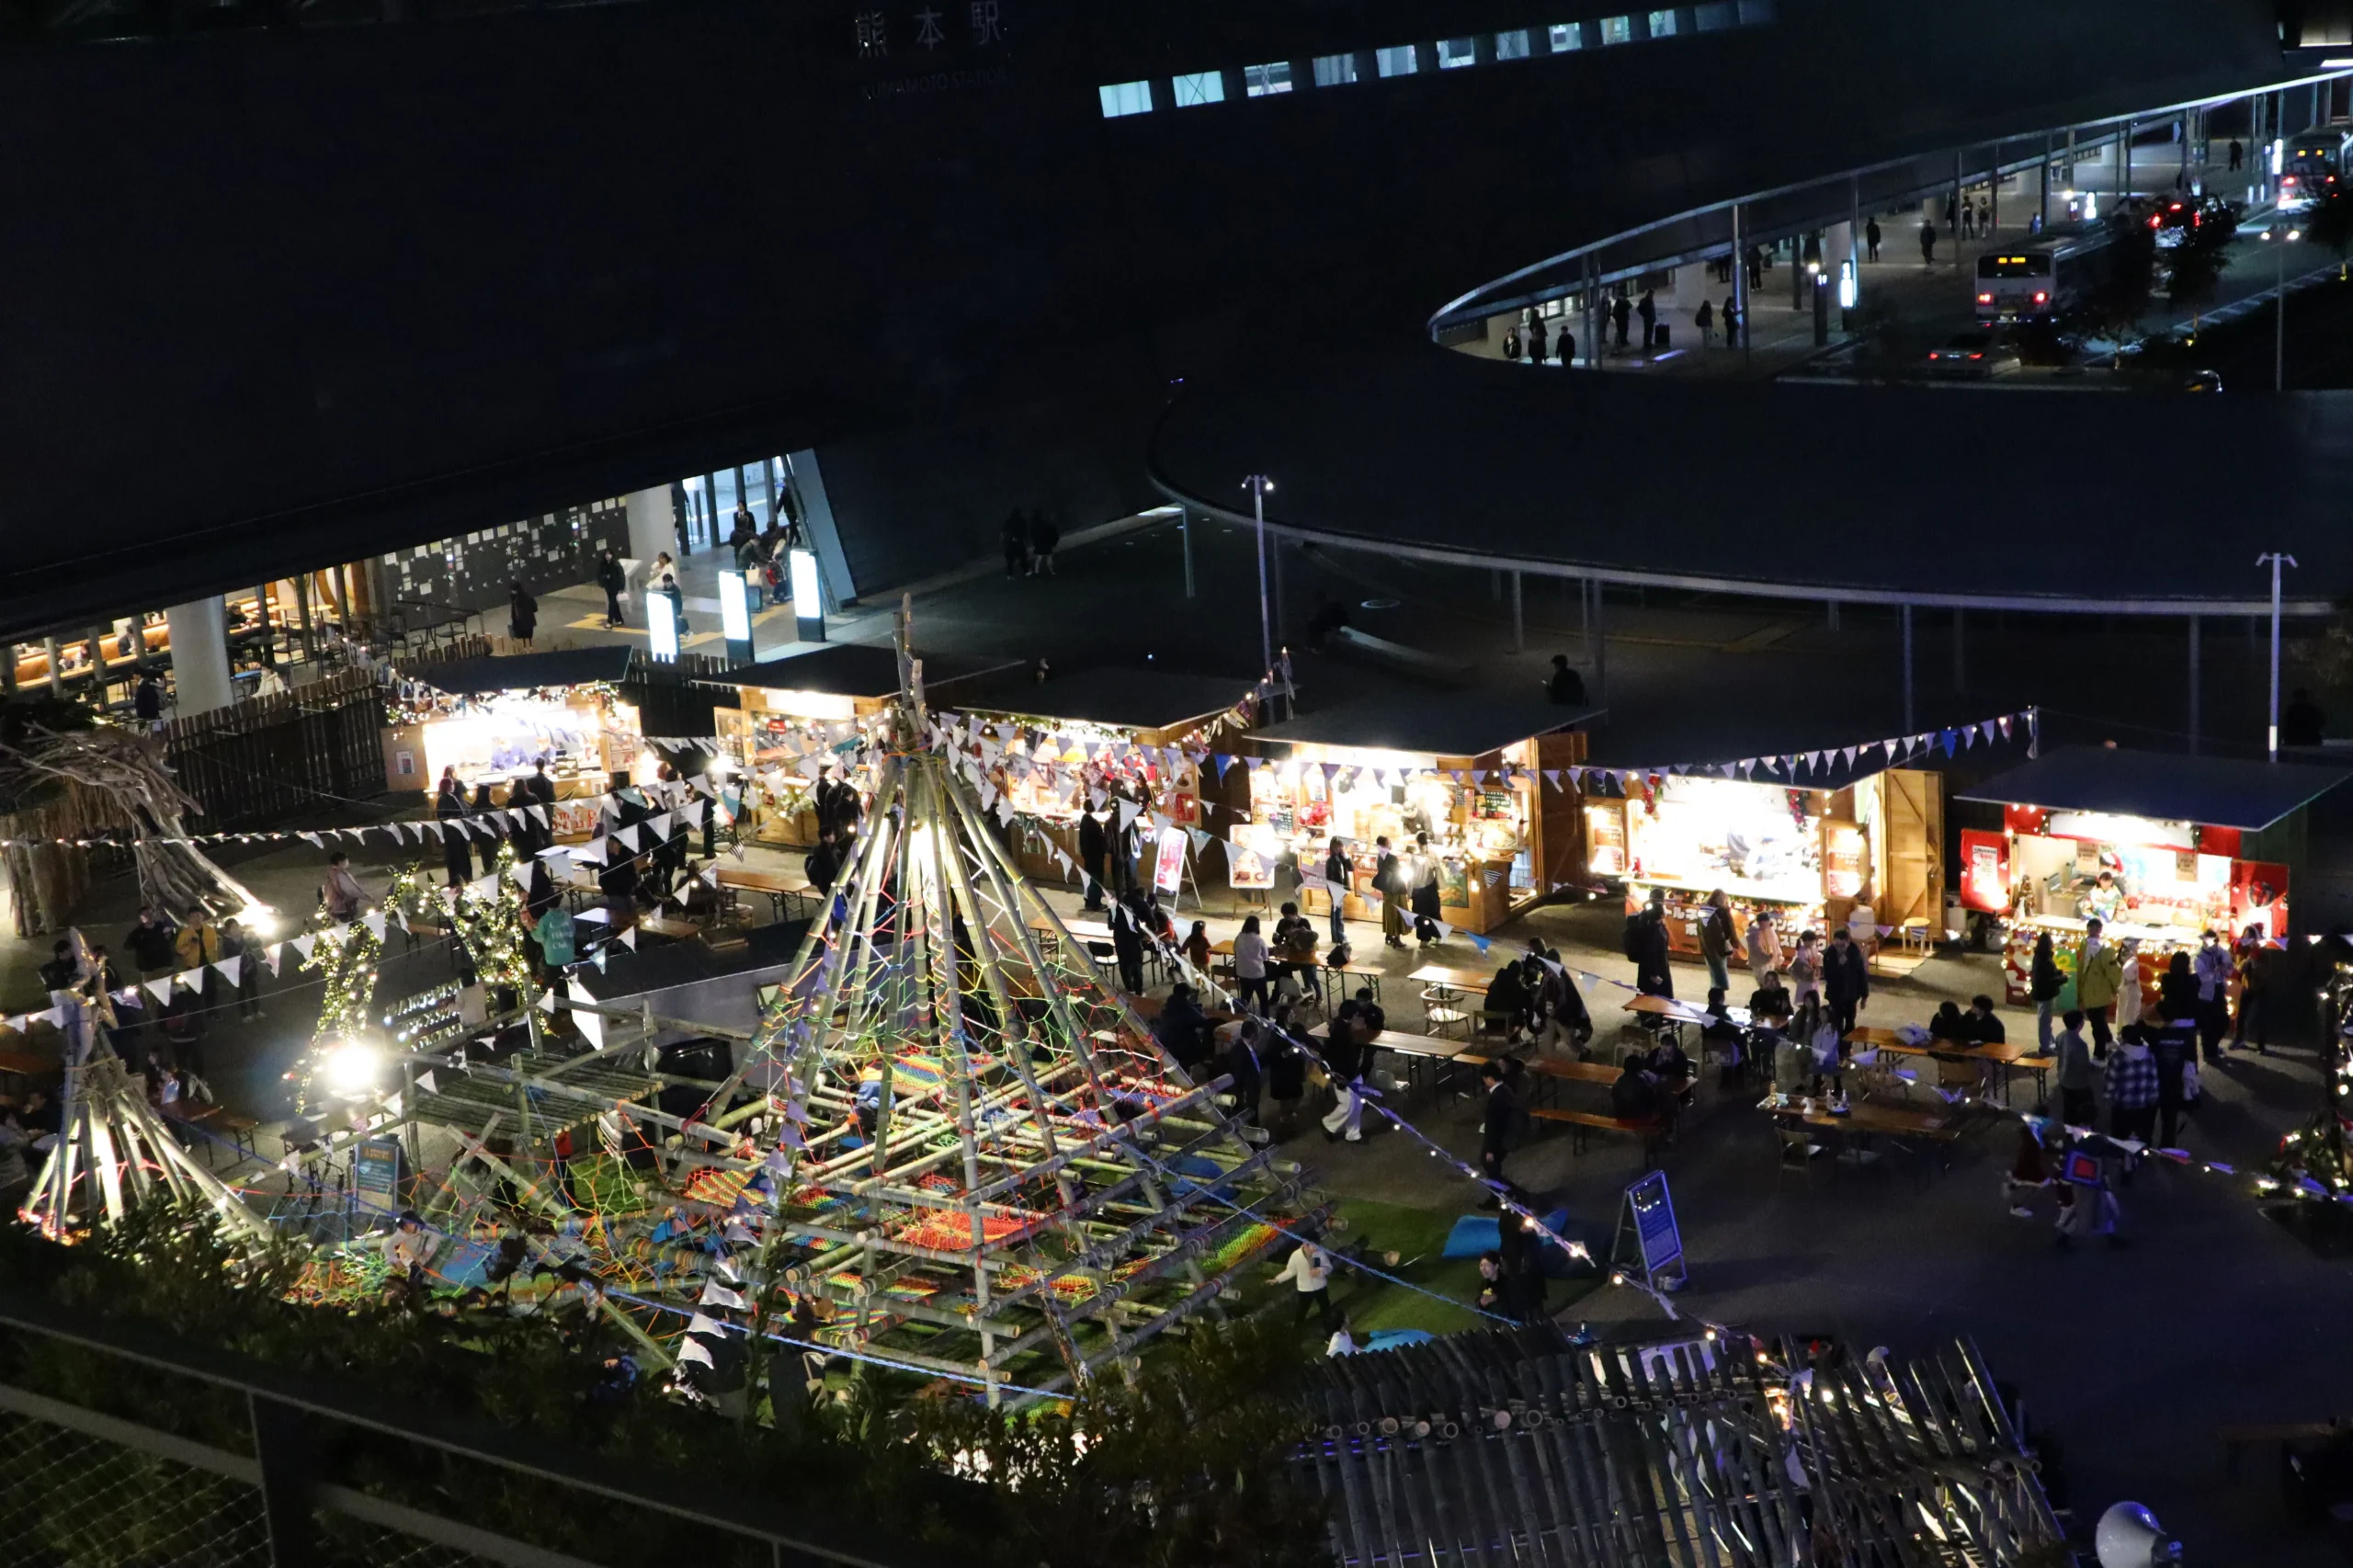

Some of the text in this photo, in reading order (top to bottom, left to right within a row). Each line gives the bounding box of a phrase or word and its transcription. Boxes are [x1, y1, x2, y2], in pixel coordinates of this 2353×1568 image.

[857, 1, 1002, 58] 熊本駅
[862, 65, 1007, 99] KUMAMOTO STATION
